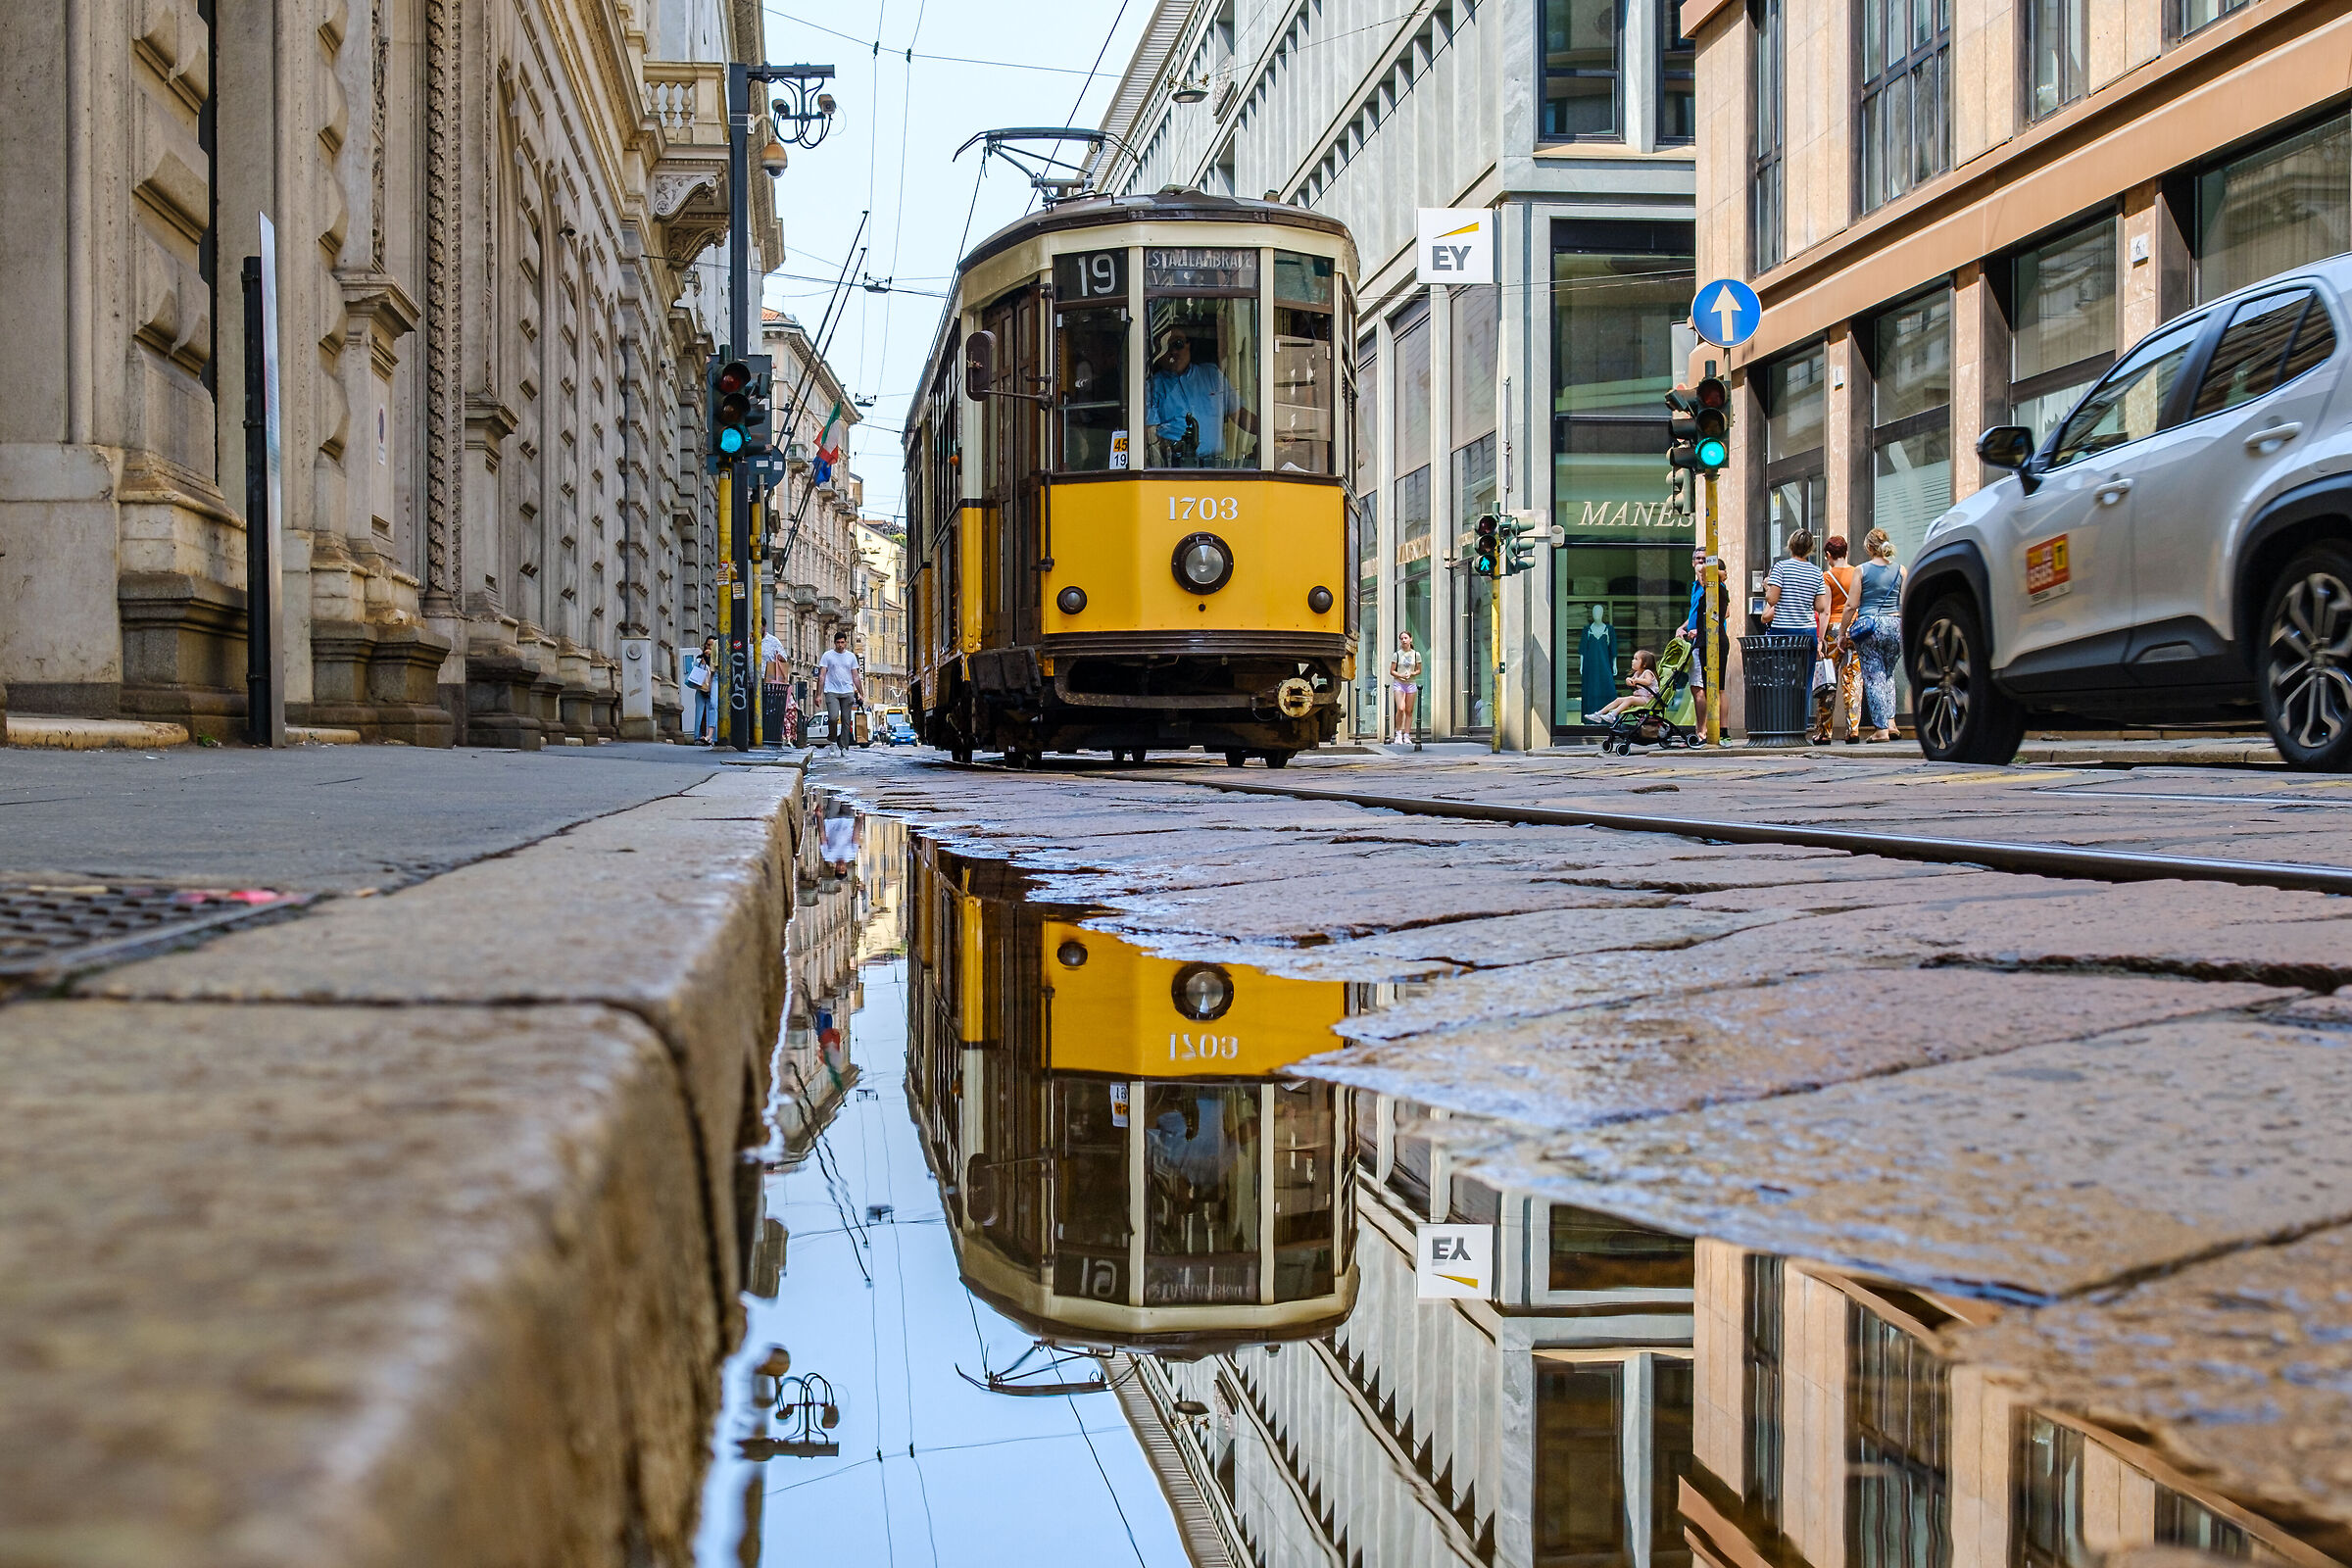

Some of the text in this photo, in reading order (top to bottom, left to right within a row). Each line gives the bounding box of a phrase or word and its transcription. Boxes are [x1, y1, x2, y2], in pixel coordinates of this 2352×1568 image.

[1432, 245, 1472, 270] EY
[1078, 254, 1116, 297] 19
[1114, 438, 1128, 452] 45
[1114, 454, 1127, 466] 19
[1168, 496, 1239, 521] 1703
